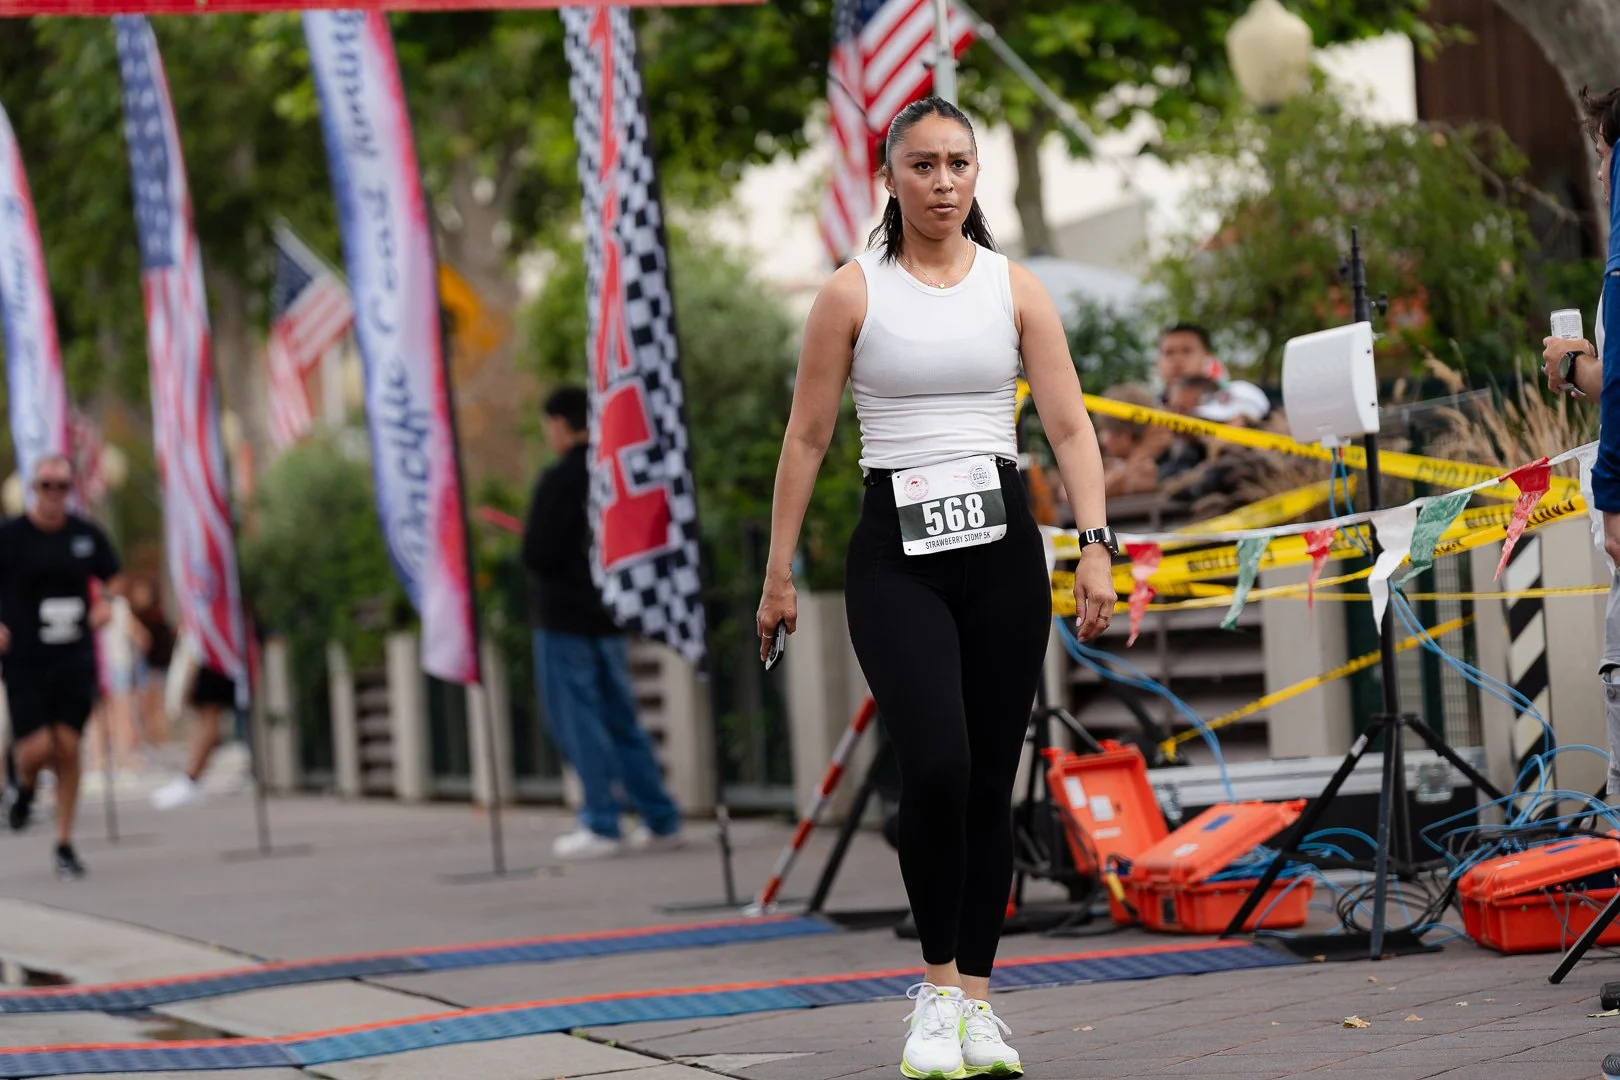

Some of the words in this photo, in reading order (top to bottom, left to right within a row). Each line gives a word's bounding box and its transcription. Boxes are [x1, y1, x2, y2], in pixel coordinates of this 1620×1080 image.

[921, 493, 986, 536] 568
[925, 535, 963, 550] STRAWBERRY
[964, 533, 983, 543] STOMP
[983, 531, 991, 540] 5K
